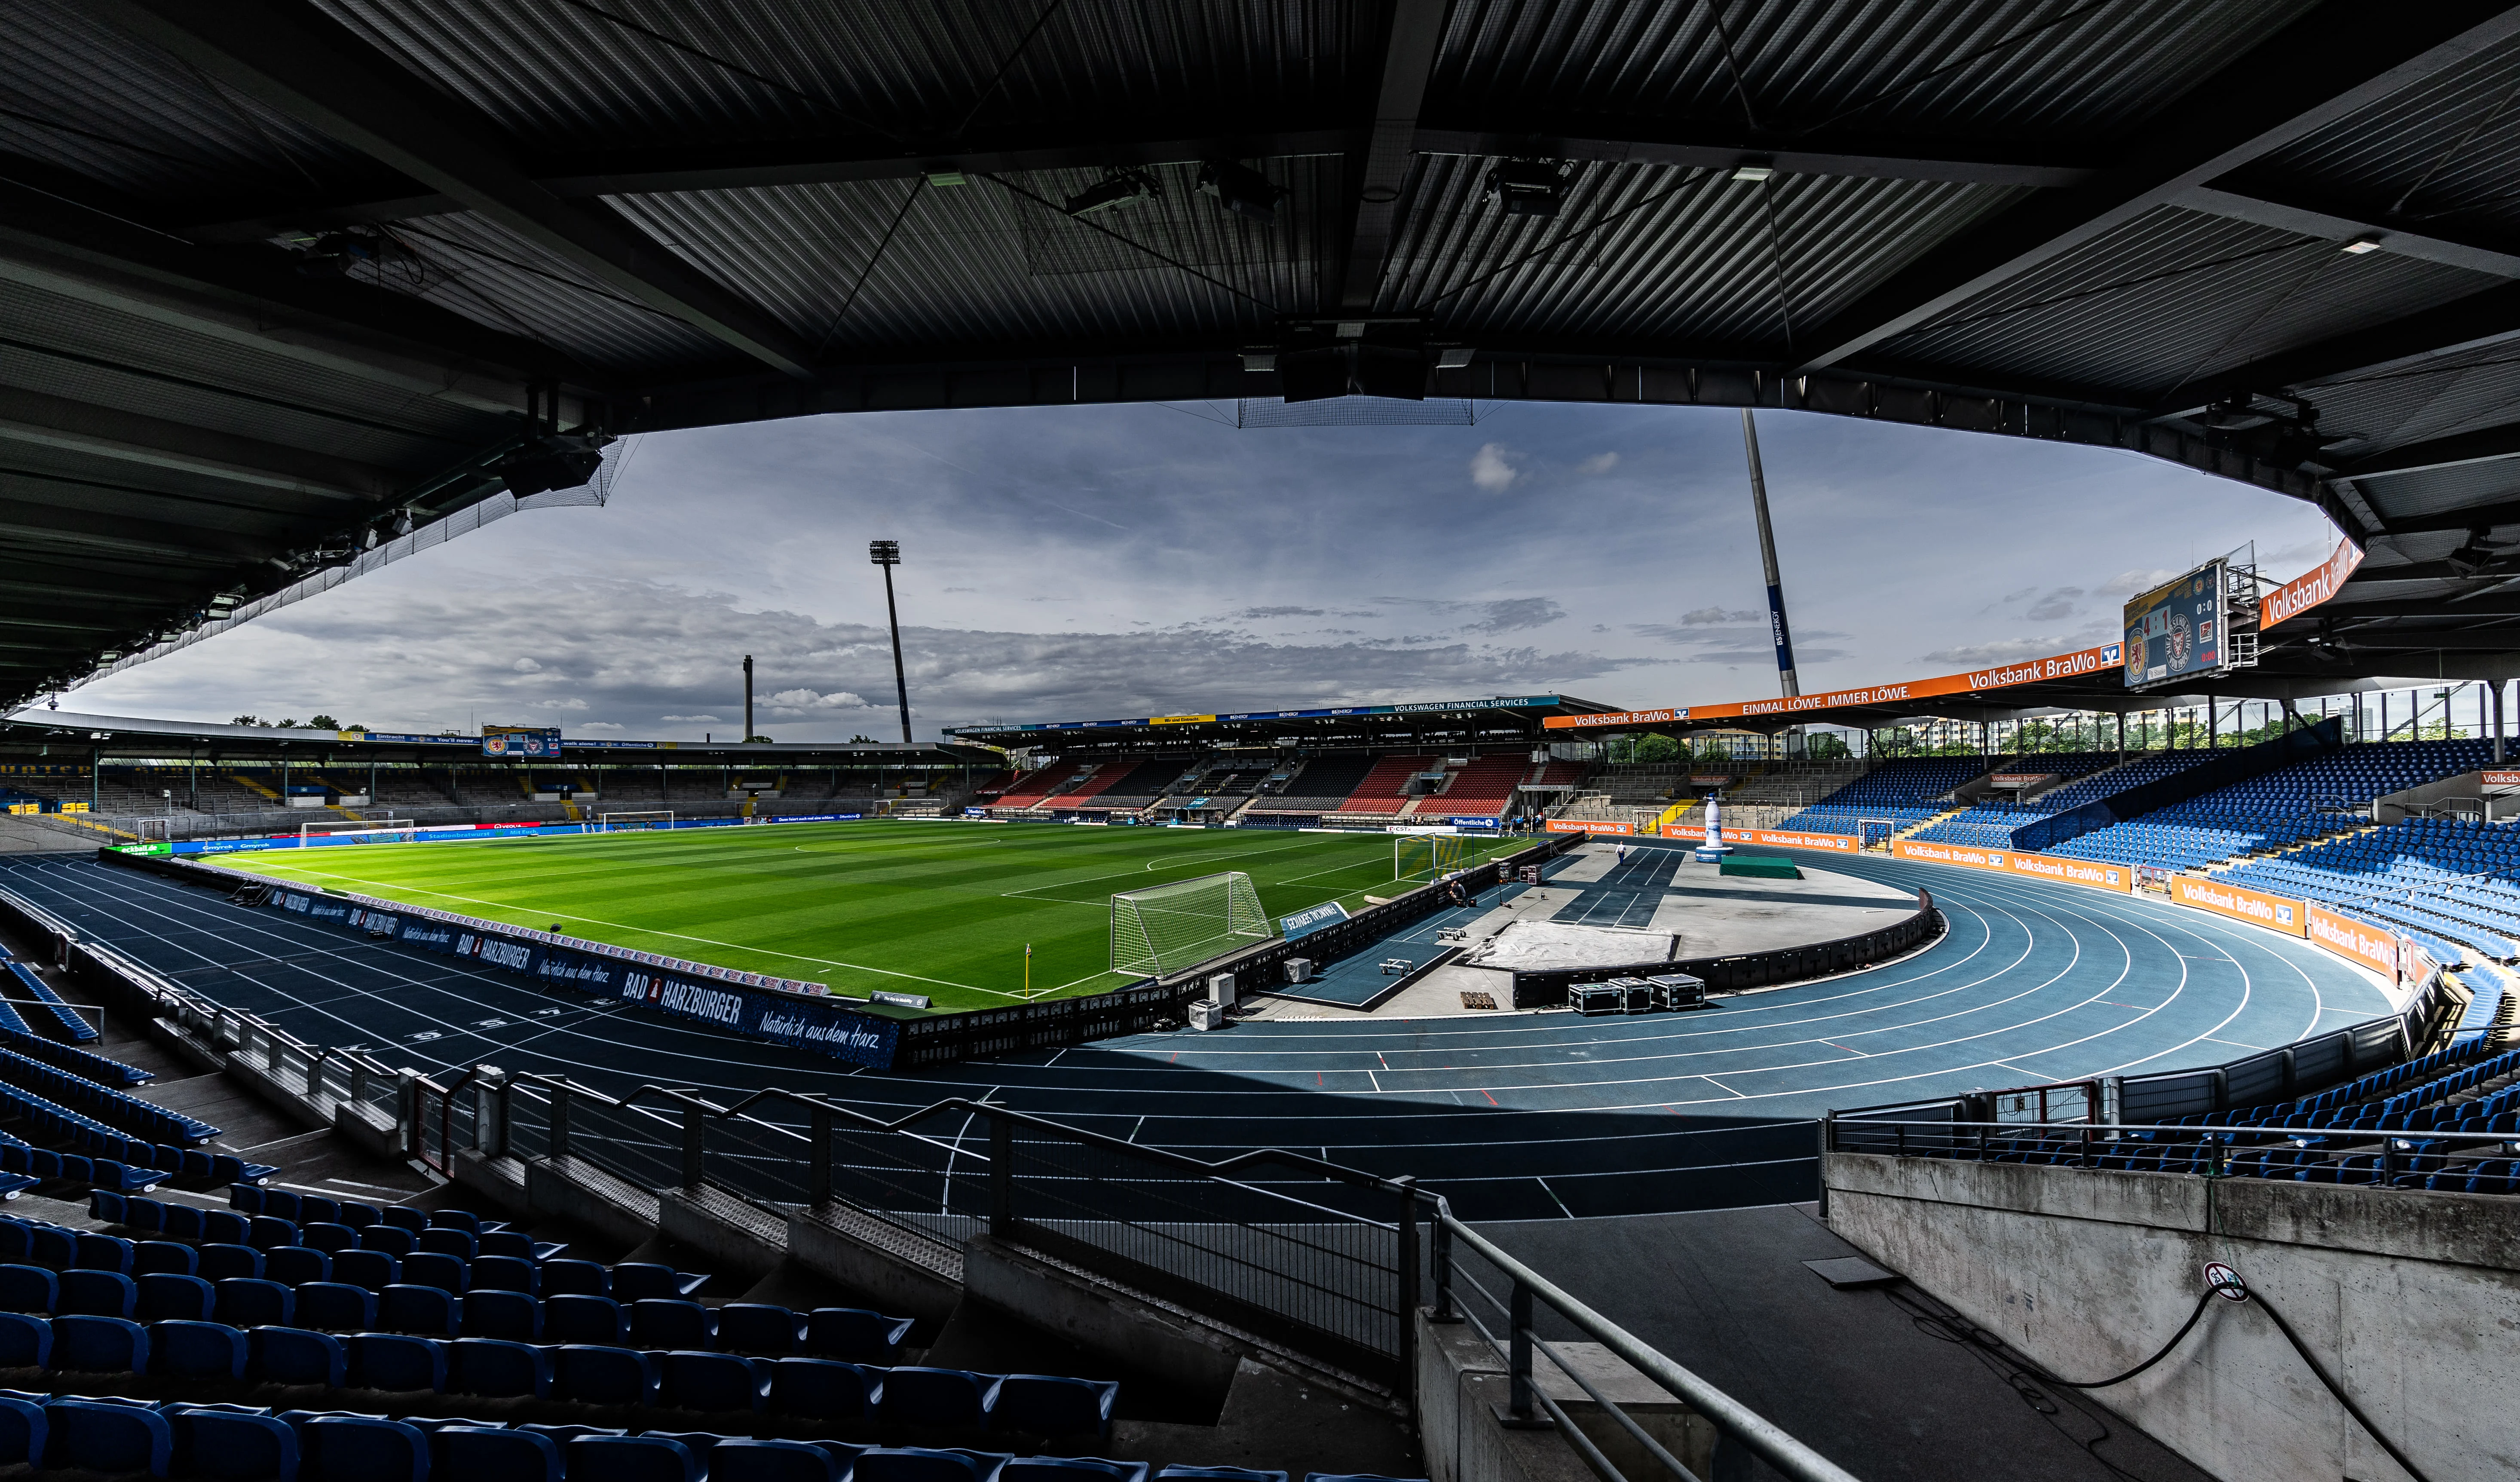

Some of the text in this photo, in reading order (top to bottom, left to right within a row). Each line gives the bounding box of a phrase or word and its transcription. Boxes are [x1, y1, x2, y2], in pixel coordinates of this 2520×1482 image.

[2268, 547, 2347, 622] Volksbank BraWo
[2196, 600, 2212, 615] 0:0
[2143, 616, 2150, 636] 4
[2162, 609, 2168, 631] 1
[2178, 652, 2187, 668] 1900
[2201, 650, 2215, 662] 0:00
[1969, 661, 2042, 689] Volksbank
[2046, 653, 2096, 678] BraWo
[1395, 698, 1528, 712] VOLKSWAGEN FINANCIAL SERVICES
[1742, 685, 1911, 714] EINMAL LÖWE. IMMER LÖWE.
[1574, 710, 1669, 726] Volksbank BraWo
[2483, 774, 2520, 783] Volksb
[1553, 822, 1614, 833] Volksbank BraWo
[1671, 828, 1706, 838] Volksban
[122, 845, 158, 853] eckball.de
[1761, 833, 1834, 848] Volksbank BraWo
[1904, 845, 1986, 864] Volksbank BraWo
[2014, 857, 2104, 882] Volksbank BraWo
[2183, 883, 2272, 919] Volksbank BraWo
[348, 908, 362, 925] BAD
[1311, 904, 1337, 921] FINANCIAL
[1287, 913, 1313, 930] SERVICES
[2312, 916, 2389, 966] Volksbank BraWo
[456, 934, 474, 955] BAD
[480, 938, 530, 969] HARZBURGER
[538, 959, 609, 983] Natürlich aus dem Harz
[622, 972, 742, 1024] BAD HARZBURGER
[759, 1011, 879, 1049] Natürlich aus dem Harz.
